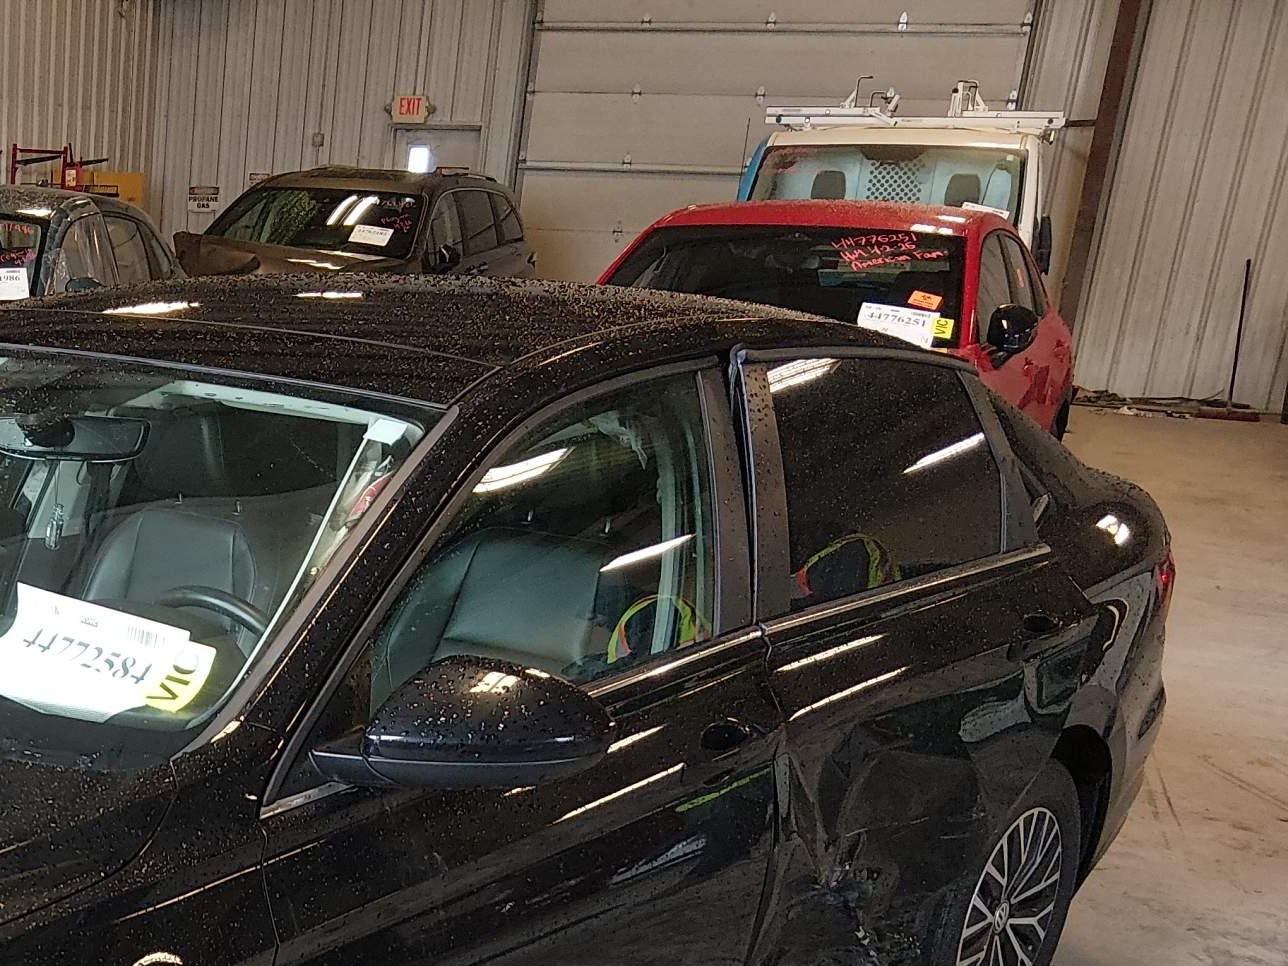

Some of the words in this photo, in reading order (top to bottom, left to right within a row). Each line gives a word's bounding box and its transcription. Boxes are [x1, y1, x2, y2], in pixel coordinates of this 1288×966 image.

[399, 97, 422, 115] EXIT
[831, 233, 917, 249] 44776251
[869, 311, 926, 327] 44776251
[935, 319, 949, 335] VIC
[23, 628, 153, 684] 44772584
[145, 653, 199, 701] VIC
